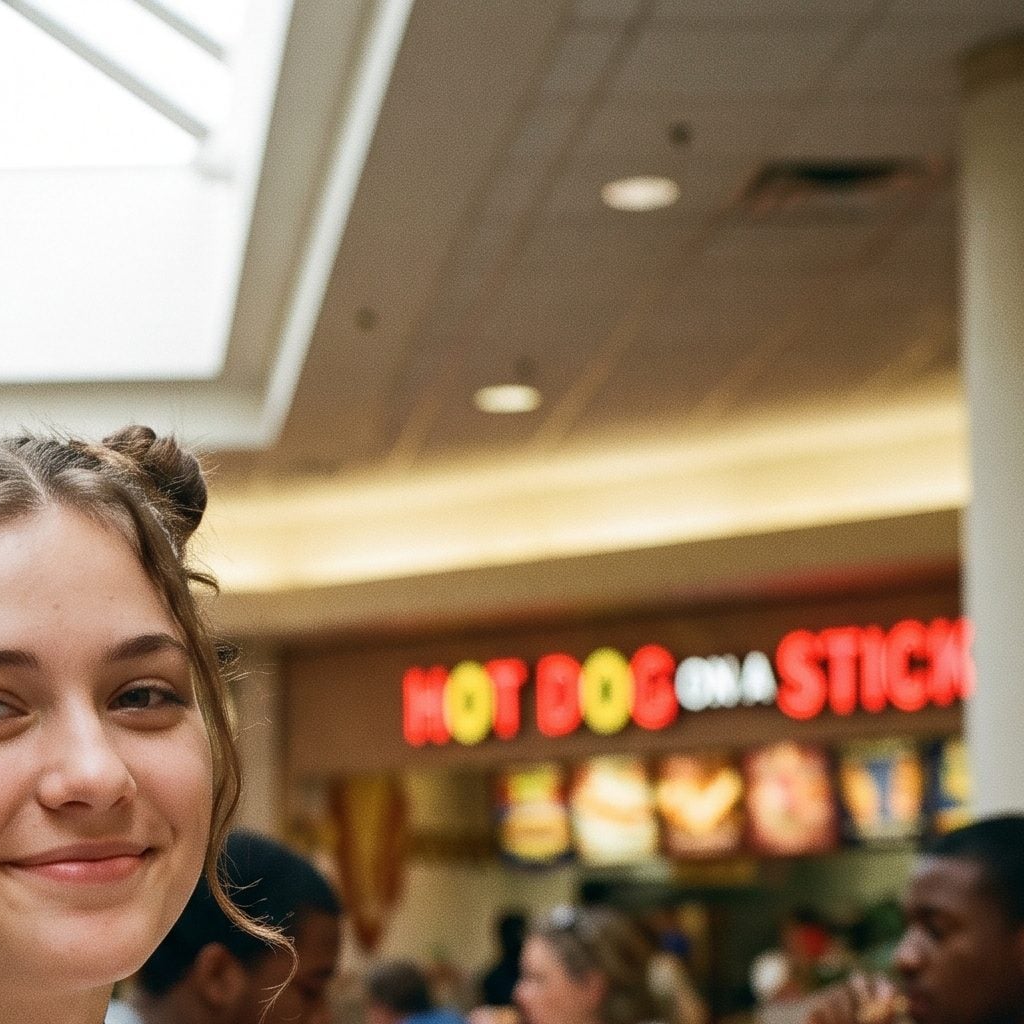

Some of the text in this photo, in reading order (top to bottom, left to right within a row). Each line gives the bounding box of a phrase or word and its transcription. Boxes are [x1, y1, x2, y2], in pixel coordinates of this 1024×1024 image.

[403, 659, 527, 746] HOT
[536, 644, 678, 735] DOG
[675, 653, 741, 711] ON
[742, 651, 776, 706] A
